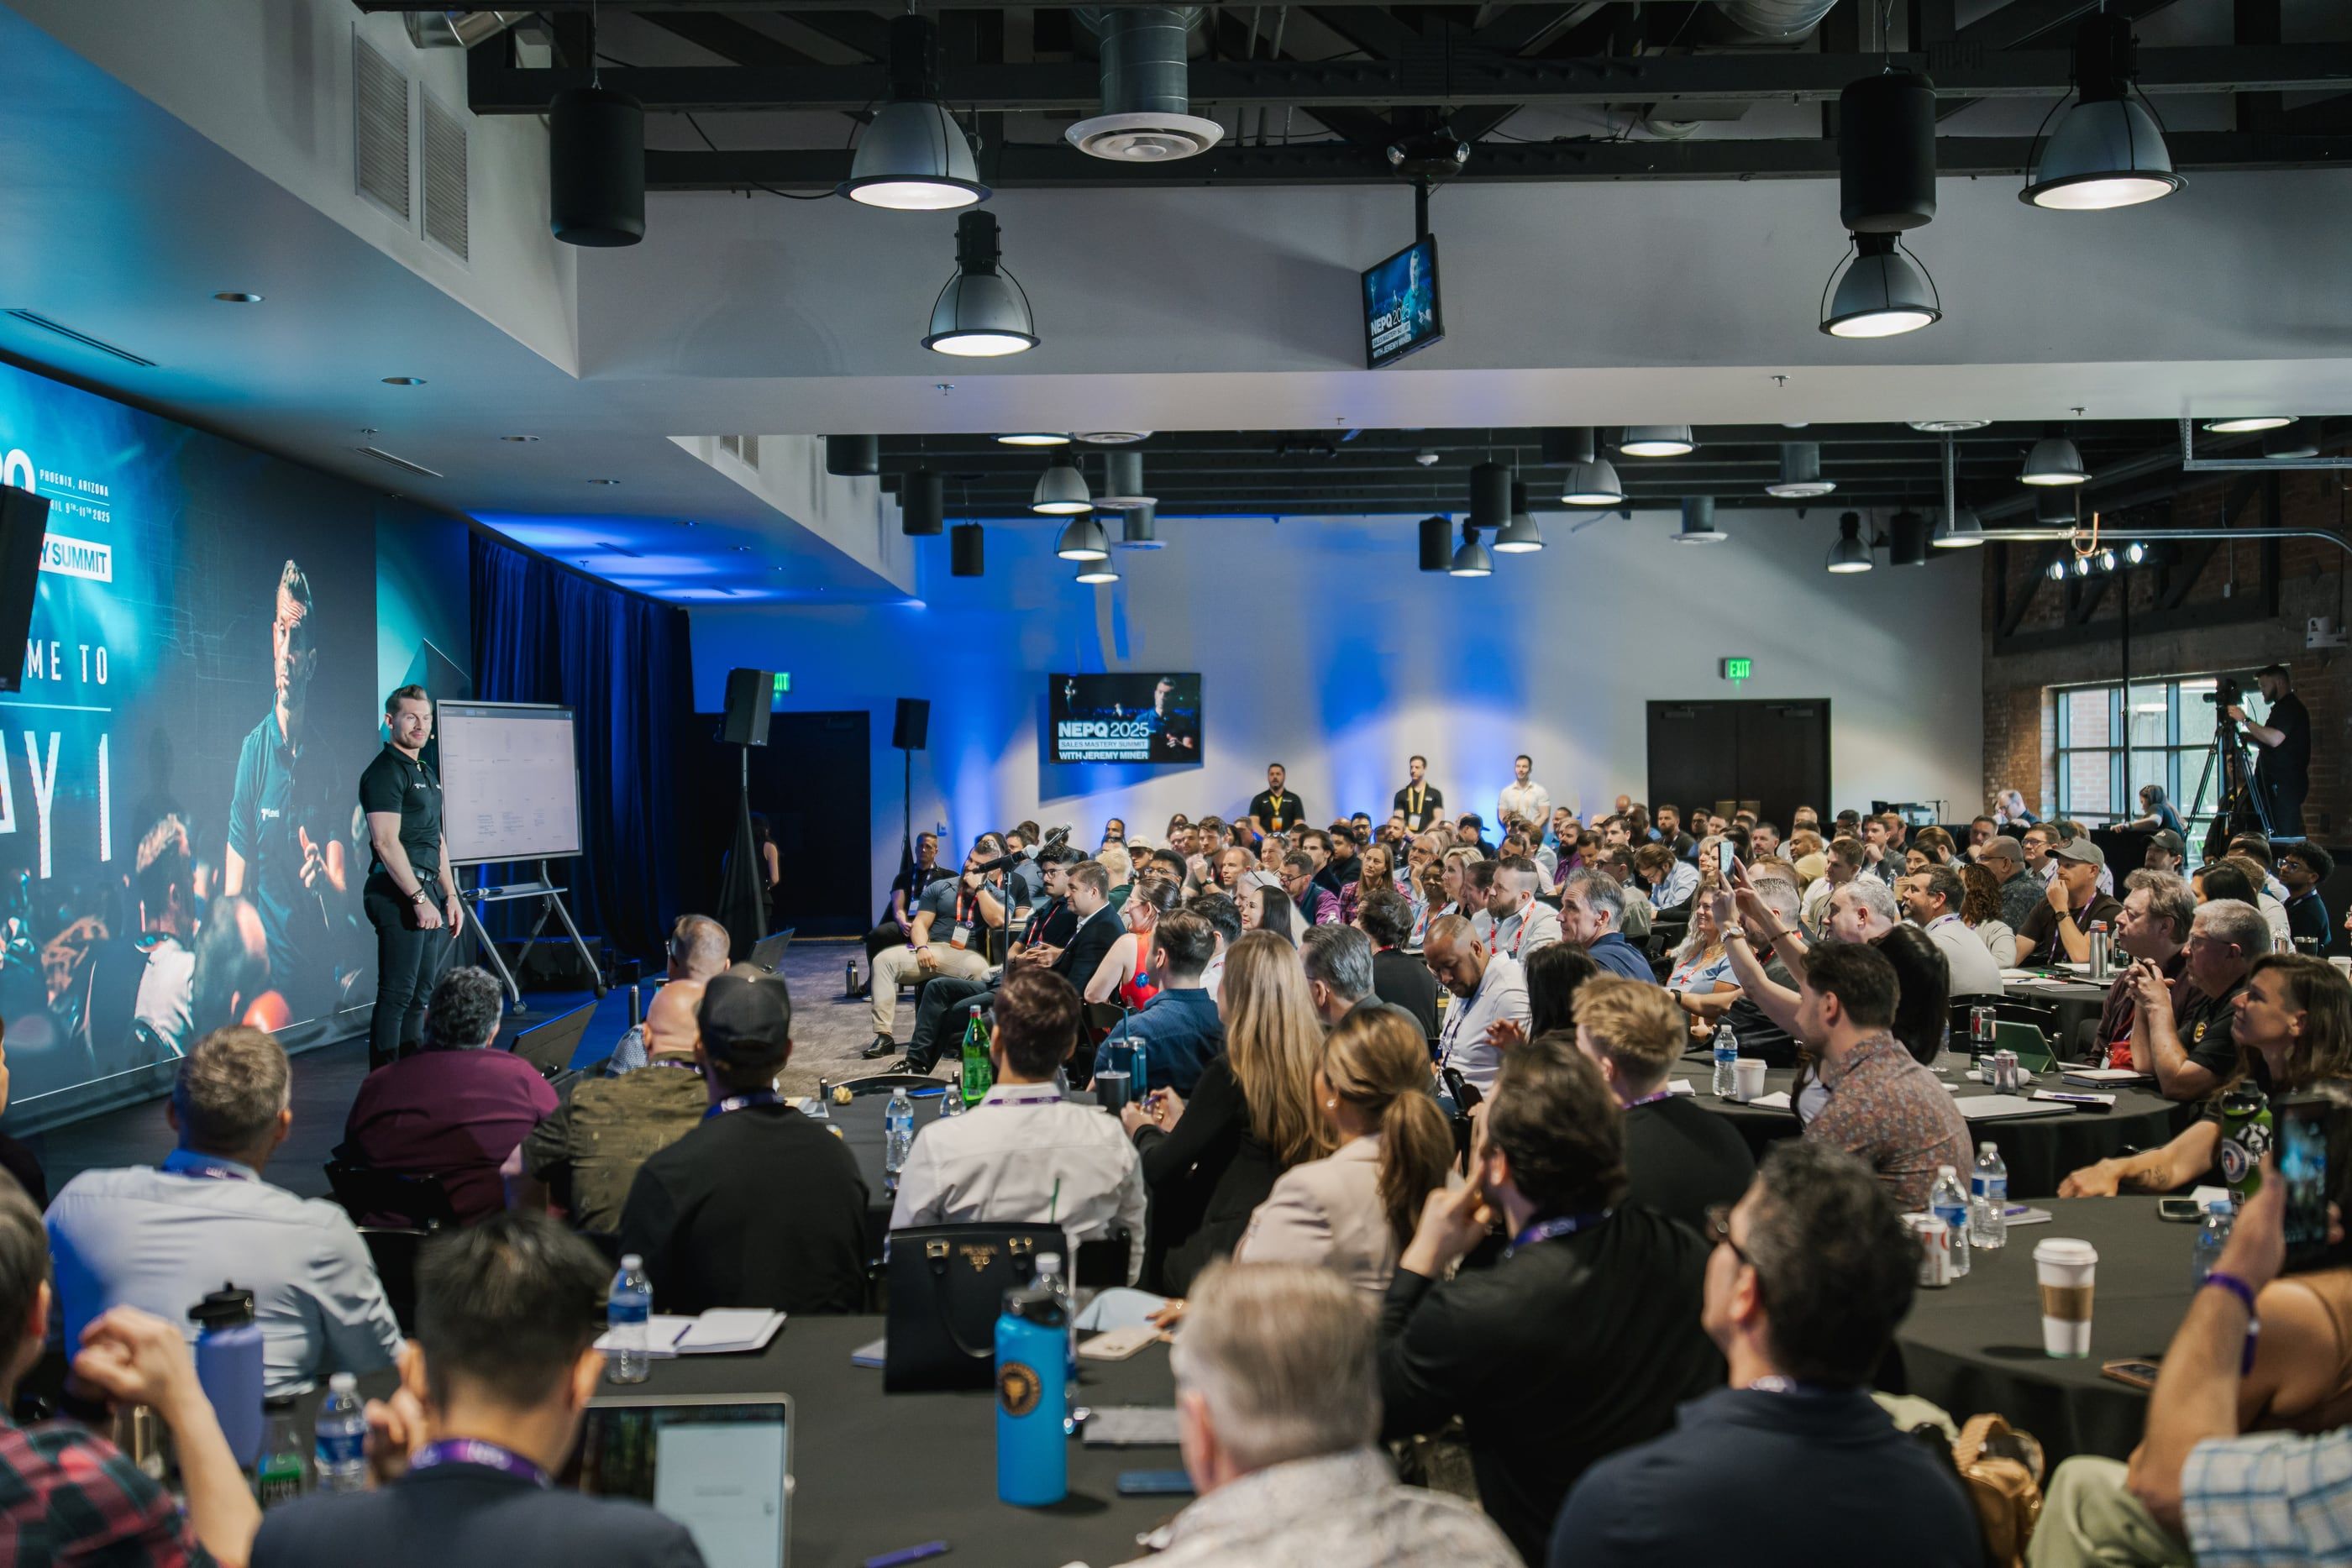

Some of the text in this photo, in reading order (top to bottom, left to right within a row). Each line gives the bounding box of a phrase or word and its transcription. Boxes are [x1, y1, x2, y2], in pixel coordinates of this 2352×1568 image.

[1371, 303, 1410, 336] NEPQ 2025
[39, 469, 108, 497] PHOENIX, ARIZONA
[92, 509, 111, 523] 2025
[52, 543, 108, 574] SUMMIT
[79, 644, 108, 685] TO
[1730, 661, 1751, 678] EXIT
[1058, 721, 1150, 737] NEPQ 2025
[1059, 751, 1148, 759] WITH JEREMY MINER
